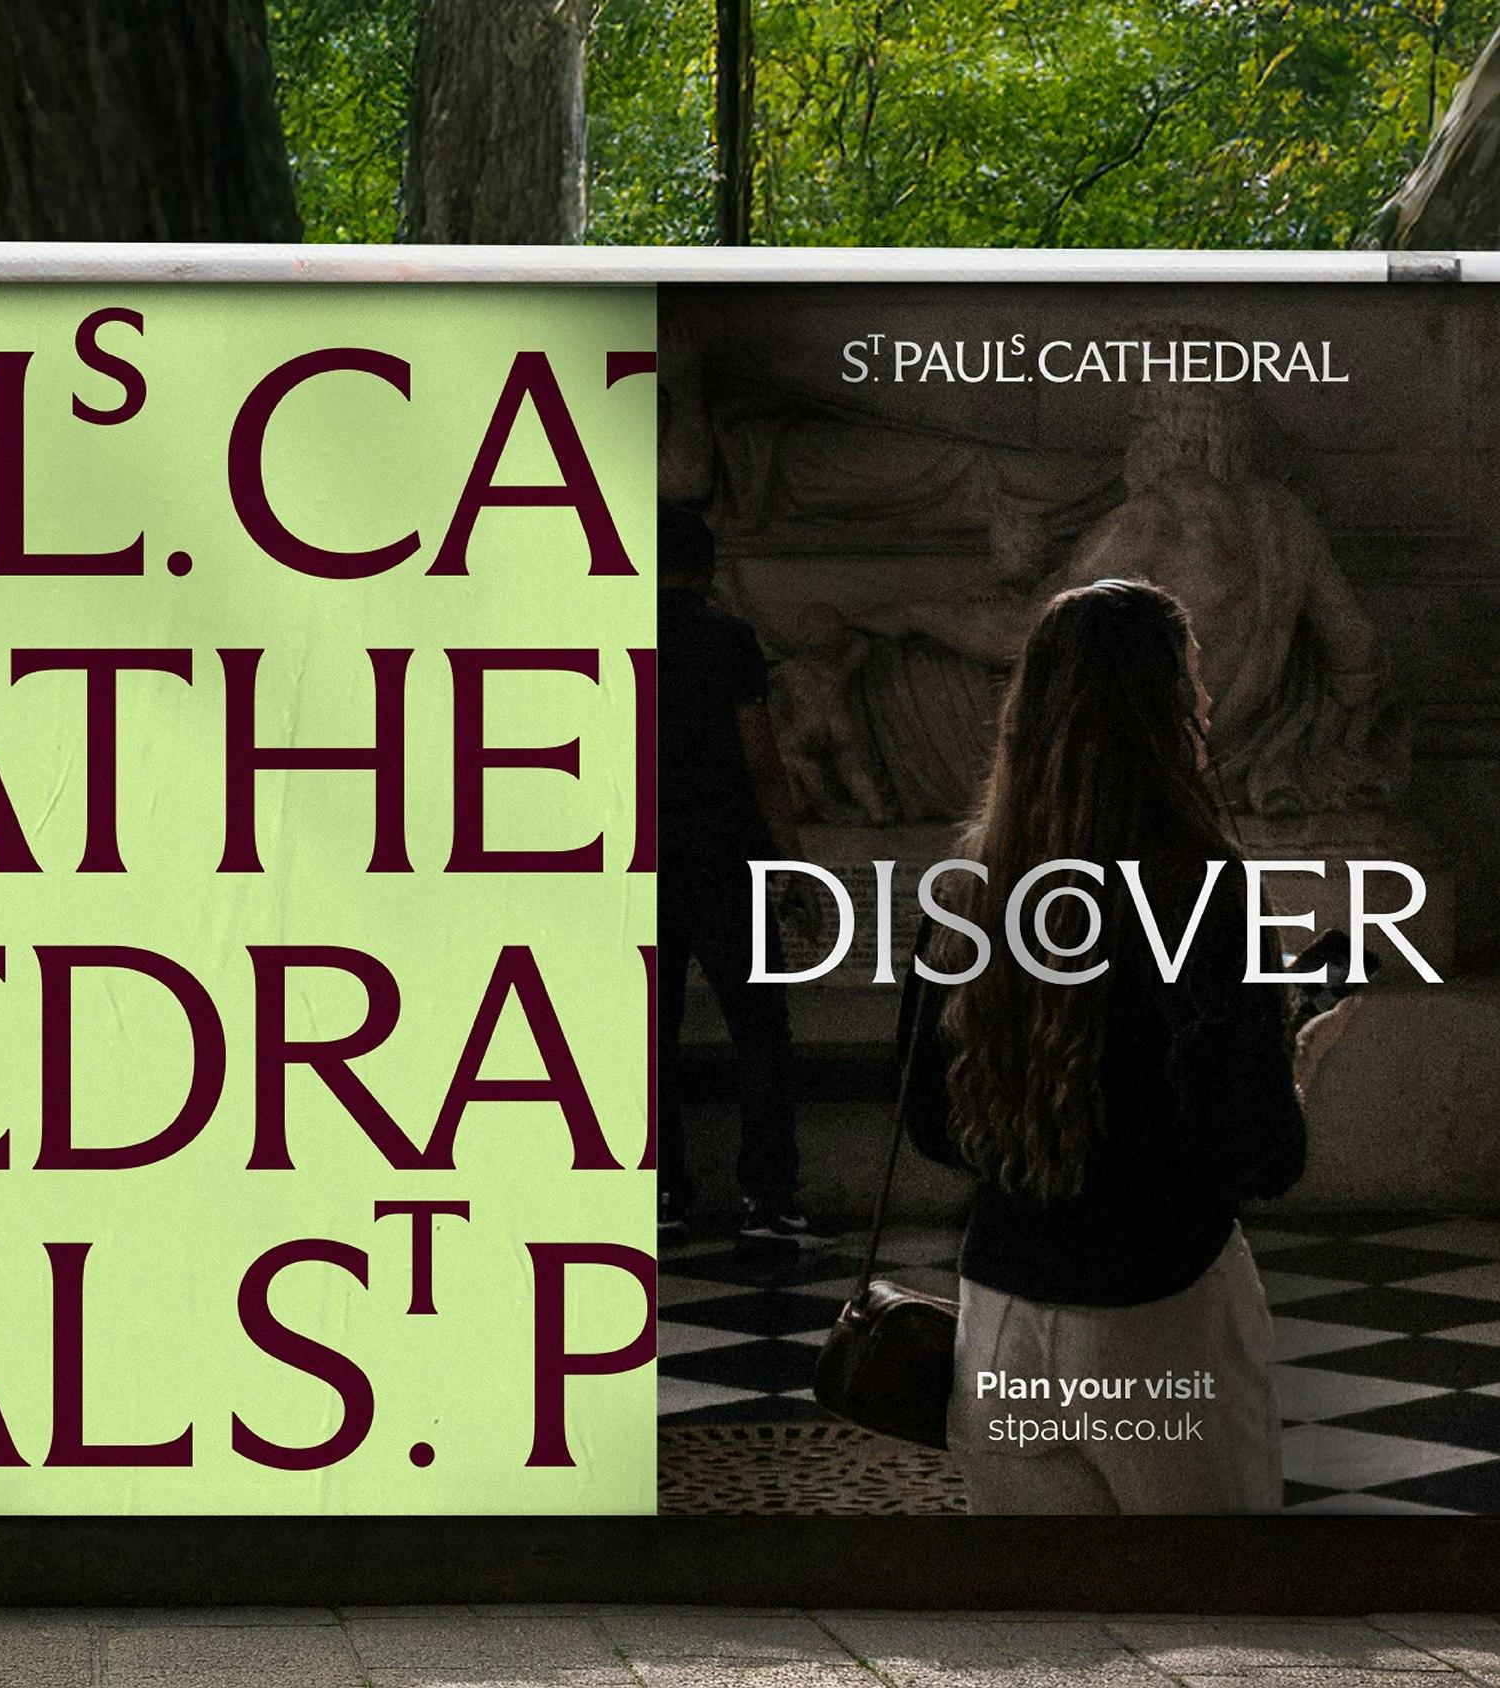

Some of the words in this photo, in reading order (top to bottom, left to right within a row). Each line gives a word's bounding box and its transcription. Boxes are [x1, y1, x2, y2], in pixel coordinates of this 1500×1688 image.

[1038, 340, 1350, 383] CATHEDRAL
[227, 347, 657, 580] CA
[746, 858, 1445, 985] DISCOVER
[976, 1370, 1050, 1399] Plan
[1059, 1378, 1138, 1407] your
[1145, 1370, 1217, 1399] visit
[988, 1412, 1204, 1448] stpauls.co.uk
